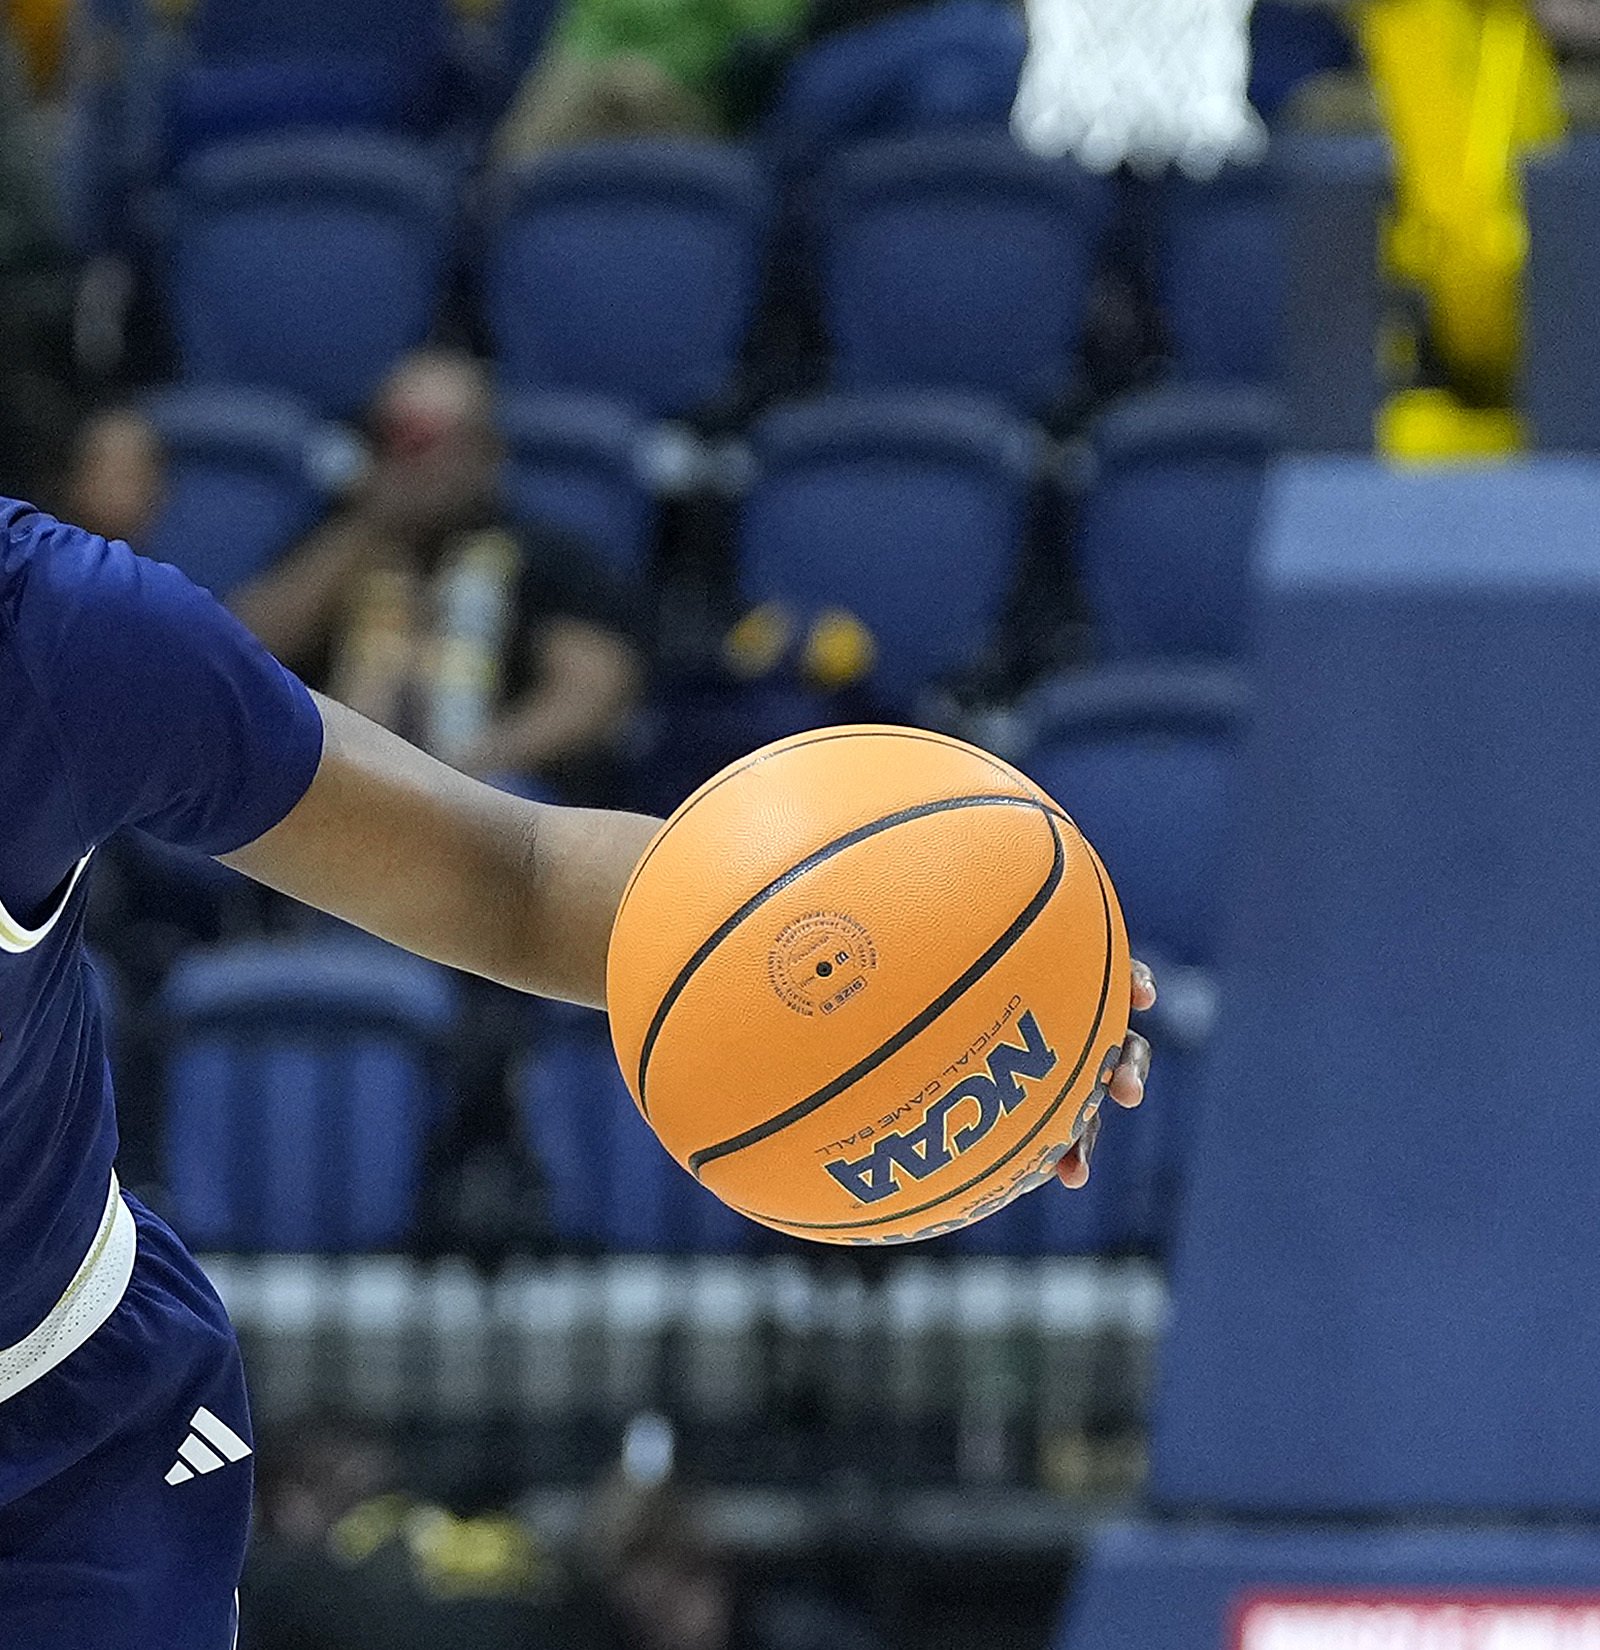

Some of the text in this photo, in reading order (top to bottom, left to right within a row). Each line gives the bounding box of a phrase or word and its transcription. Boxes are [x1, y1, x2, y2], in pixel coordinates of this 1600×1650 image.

[835, 980, 862, 1003] SIZE
[815, 995, 1021, 1154] OFFICIAL GAME BALL
[823, 1009, 1059, 1204] NCAA
